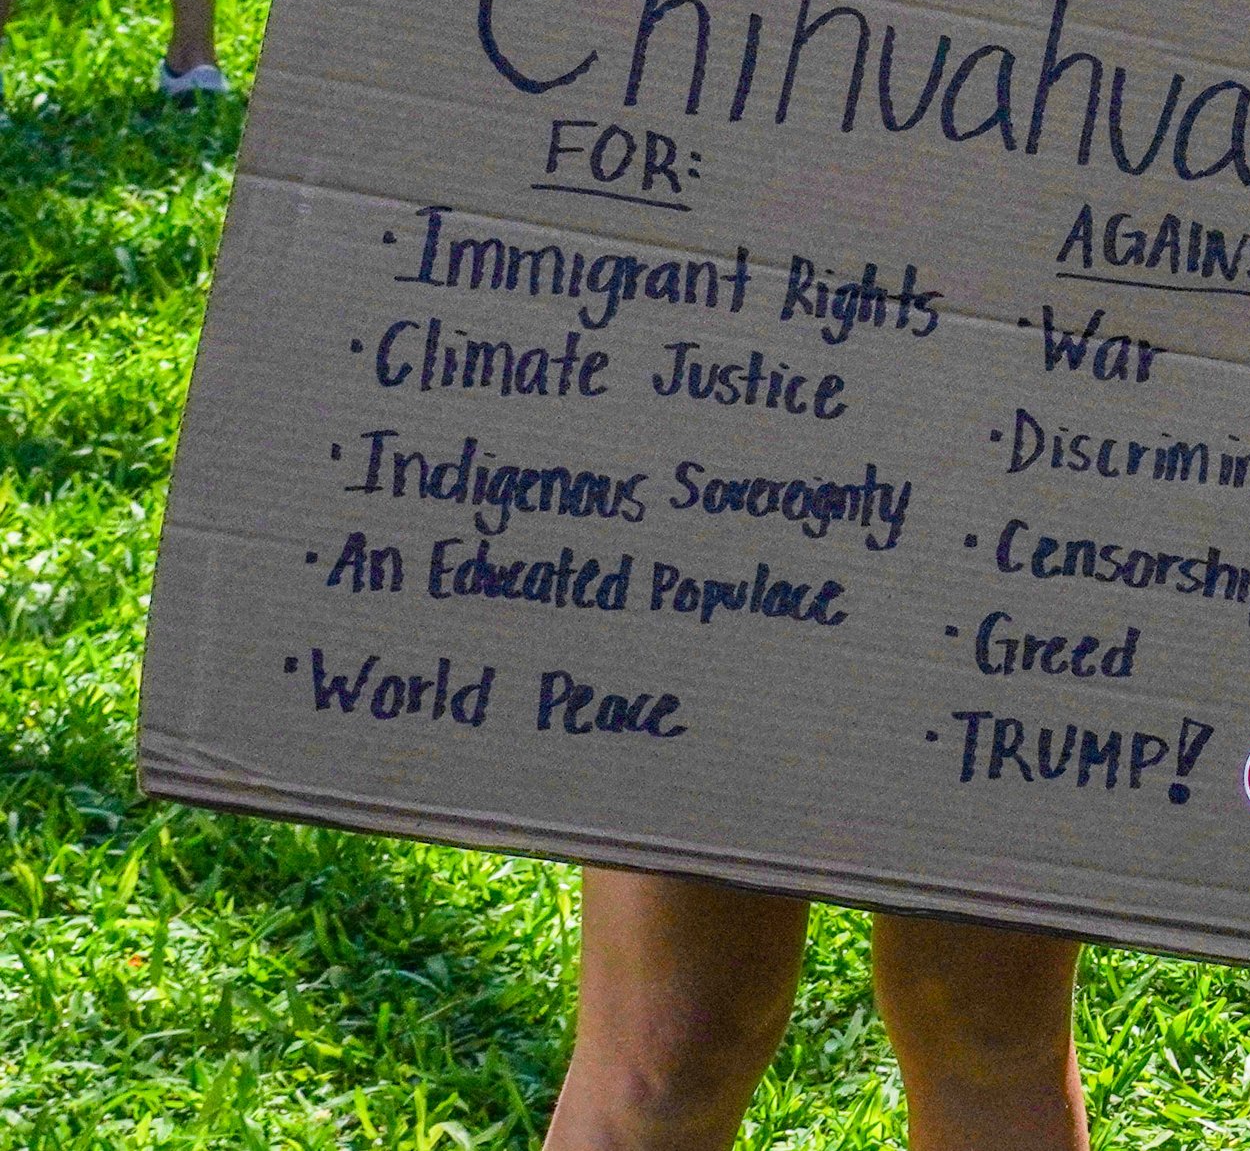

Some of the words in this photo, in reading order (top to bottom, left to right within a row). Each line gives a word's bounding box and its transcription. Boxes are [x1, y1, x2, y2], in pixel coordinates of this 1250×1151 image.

[545, 119, 702, 193] FOR:
[394, 205, 752, 330] Immigrant
[780, 254, 945, 346] Rights
[375, 317, 610, 398] Climate
[652, 341, 849, 420] Justice
[1042, 304, 1169, 384] War
[343, 429, 650, 536] Indigenous
[326, 531, 405, 593] An
[428, 537, 635, 612] Educated
[650, 561, 849, 627] Populace
[975, 610, 1142, 678] Greed
[311, 648, 497, 728] World
[537, 669, 689, 740] Peace
[951, 710, 1215, 806] TRUMP!
